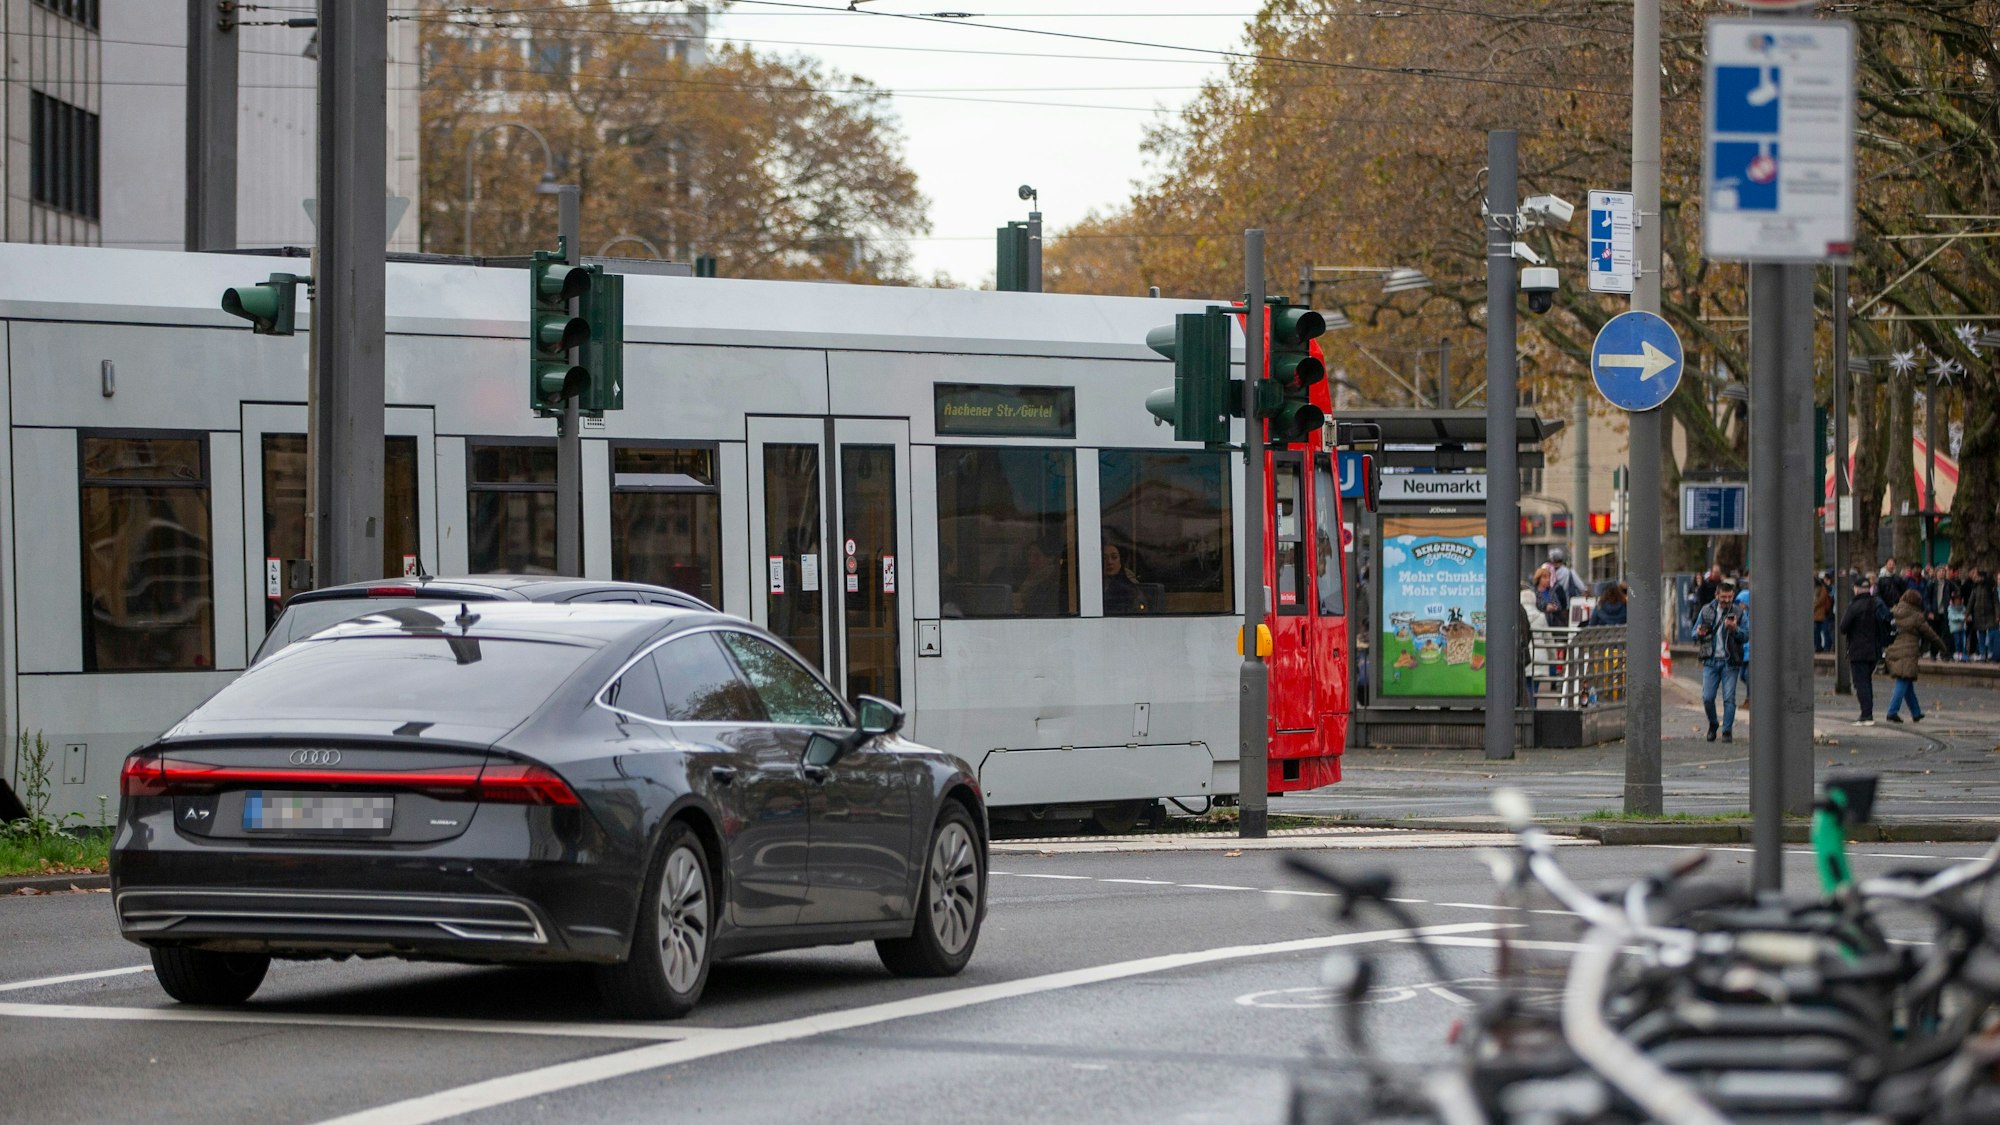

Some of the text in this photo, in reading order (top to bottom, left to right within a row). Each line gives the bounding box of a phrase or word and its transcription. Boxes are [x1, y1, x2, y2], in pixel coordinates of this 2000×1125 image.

[944, 403, 993, 416] Aachener
[1403, 479, 1482, 493] Neumarkt
[1398, 571, 1433, 583] Mehr
[1402, 584, 1485, 596] Mehr Swirls!
[1427, 605, 1442, 614] NEU
[185, 808, 210, 820] A7
